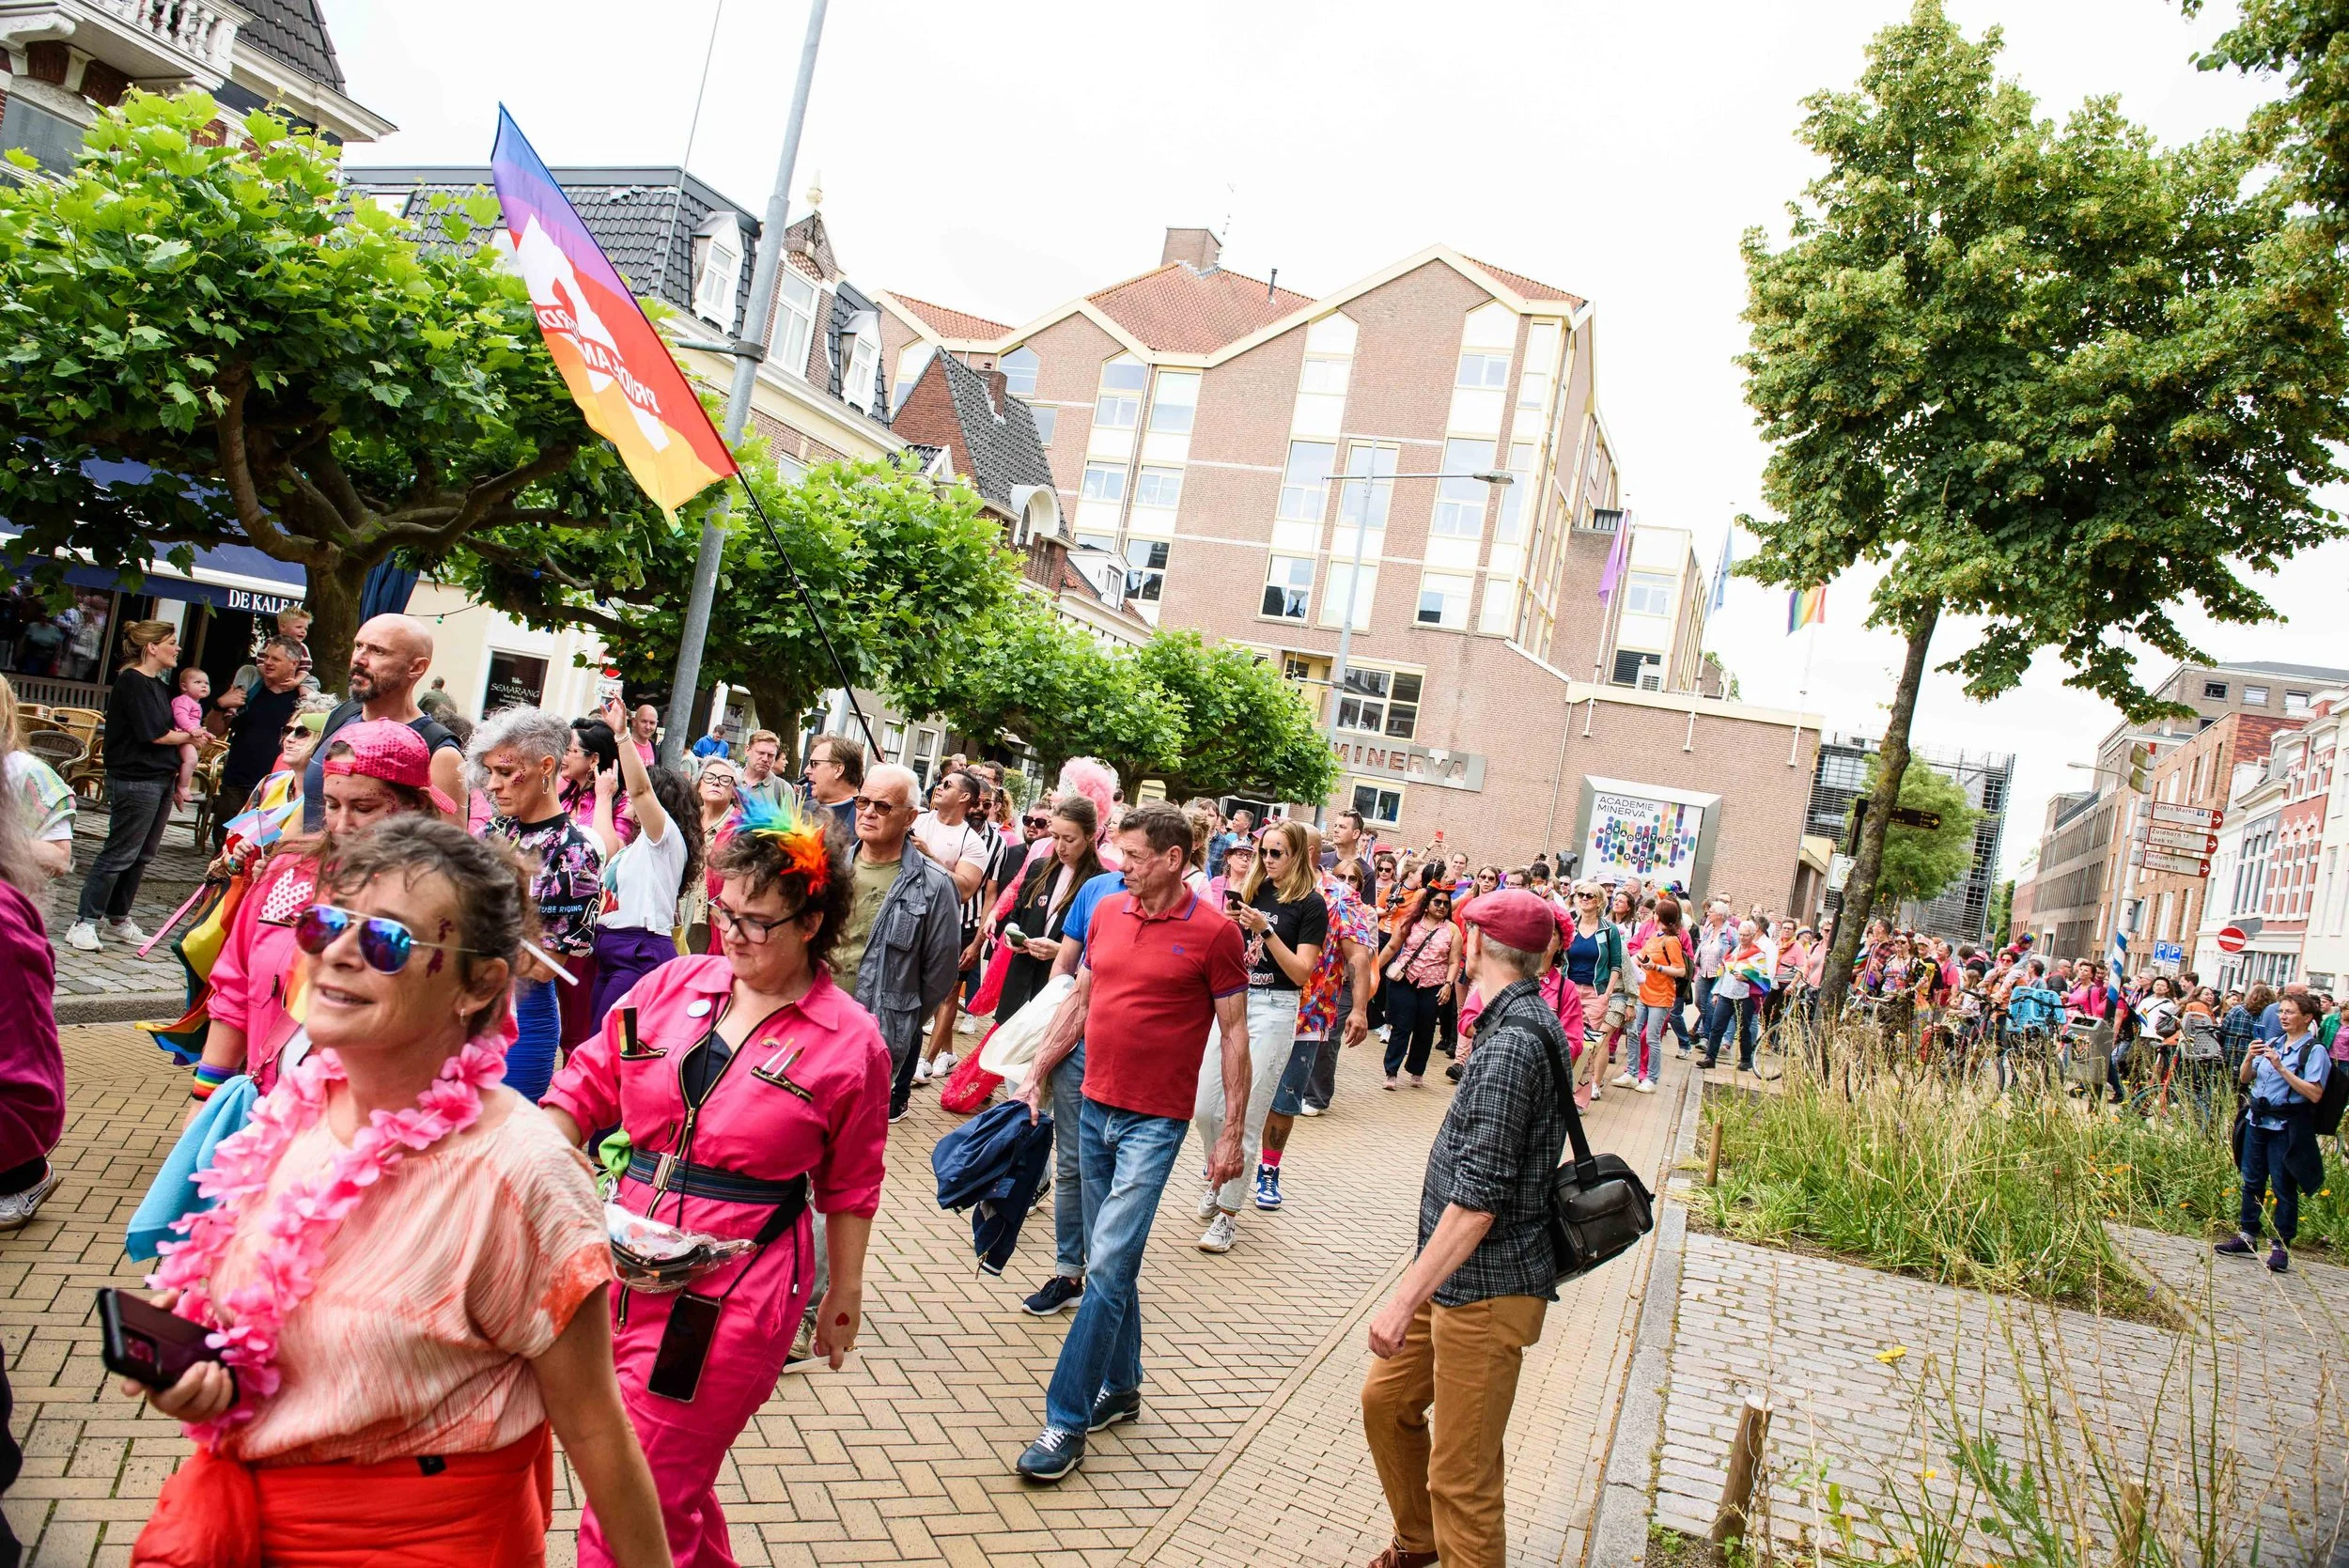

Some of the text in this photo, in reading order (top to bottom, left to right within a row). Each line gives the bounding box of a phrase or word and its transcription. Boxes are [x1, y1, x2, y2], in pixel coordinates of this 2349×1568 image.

[228, 589, 250, 609] DE
[252, 594, 288, 613] KALE
[490, 682, 540, 698] SEMARANG
[1334, 741, 1466, 782] MINERVA
[1597, 803, 1646, 819] MINERVA
[1599, 796, 1654, 812] ACADEMIE
[1605, 825, 1680, 847] GRADUATION
[2152, 829, 2182, 838] Zuidhorn
[1624, 852, 1655, 864] SHOW
[2146, 861, 2171, 869] Winsum
[2157, 943, 2166, 953] P
[2170, 946, 2180, 956] P
